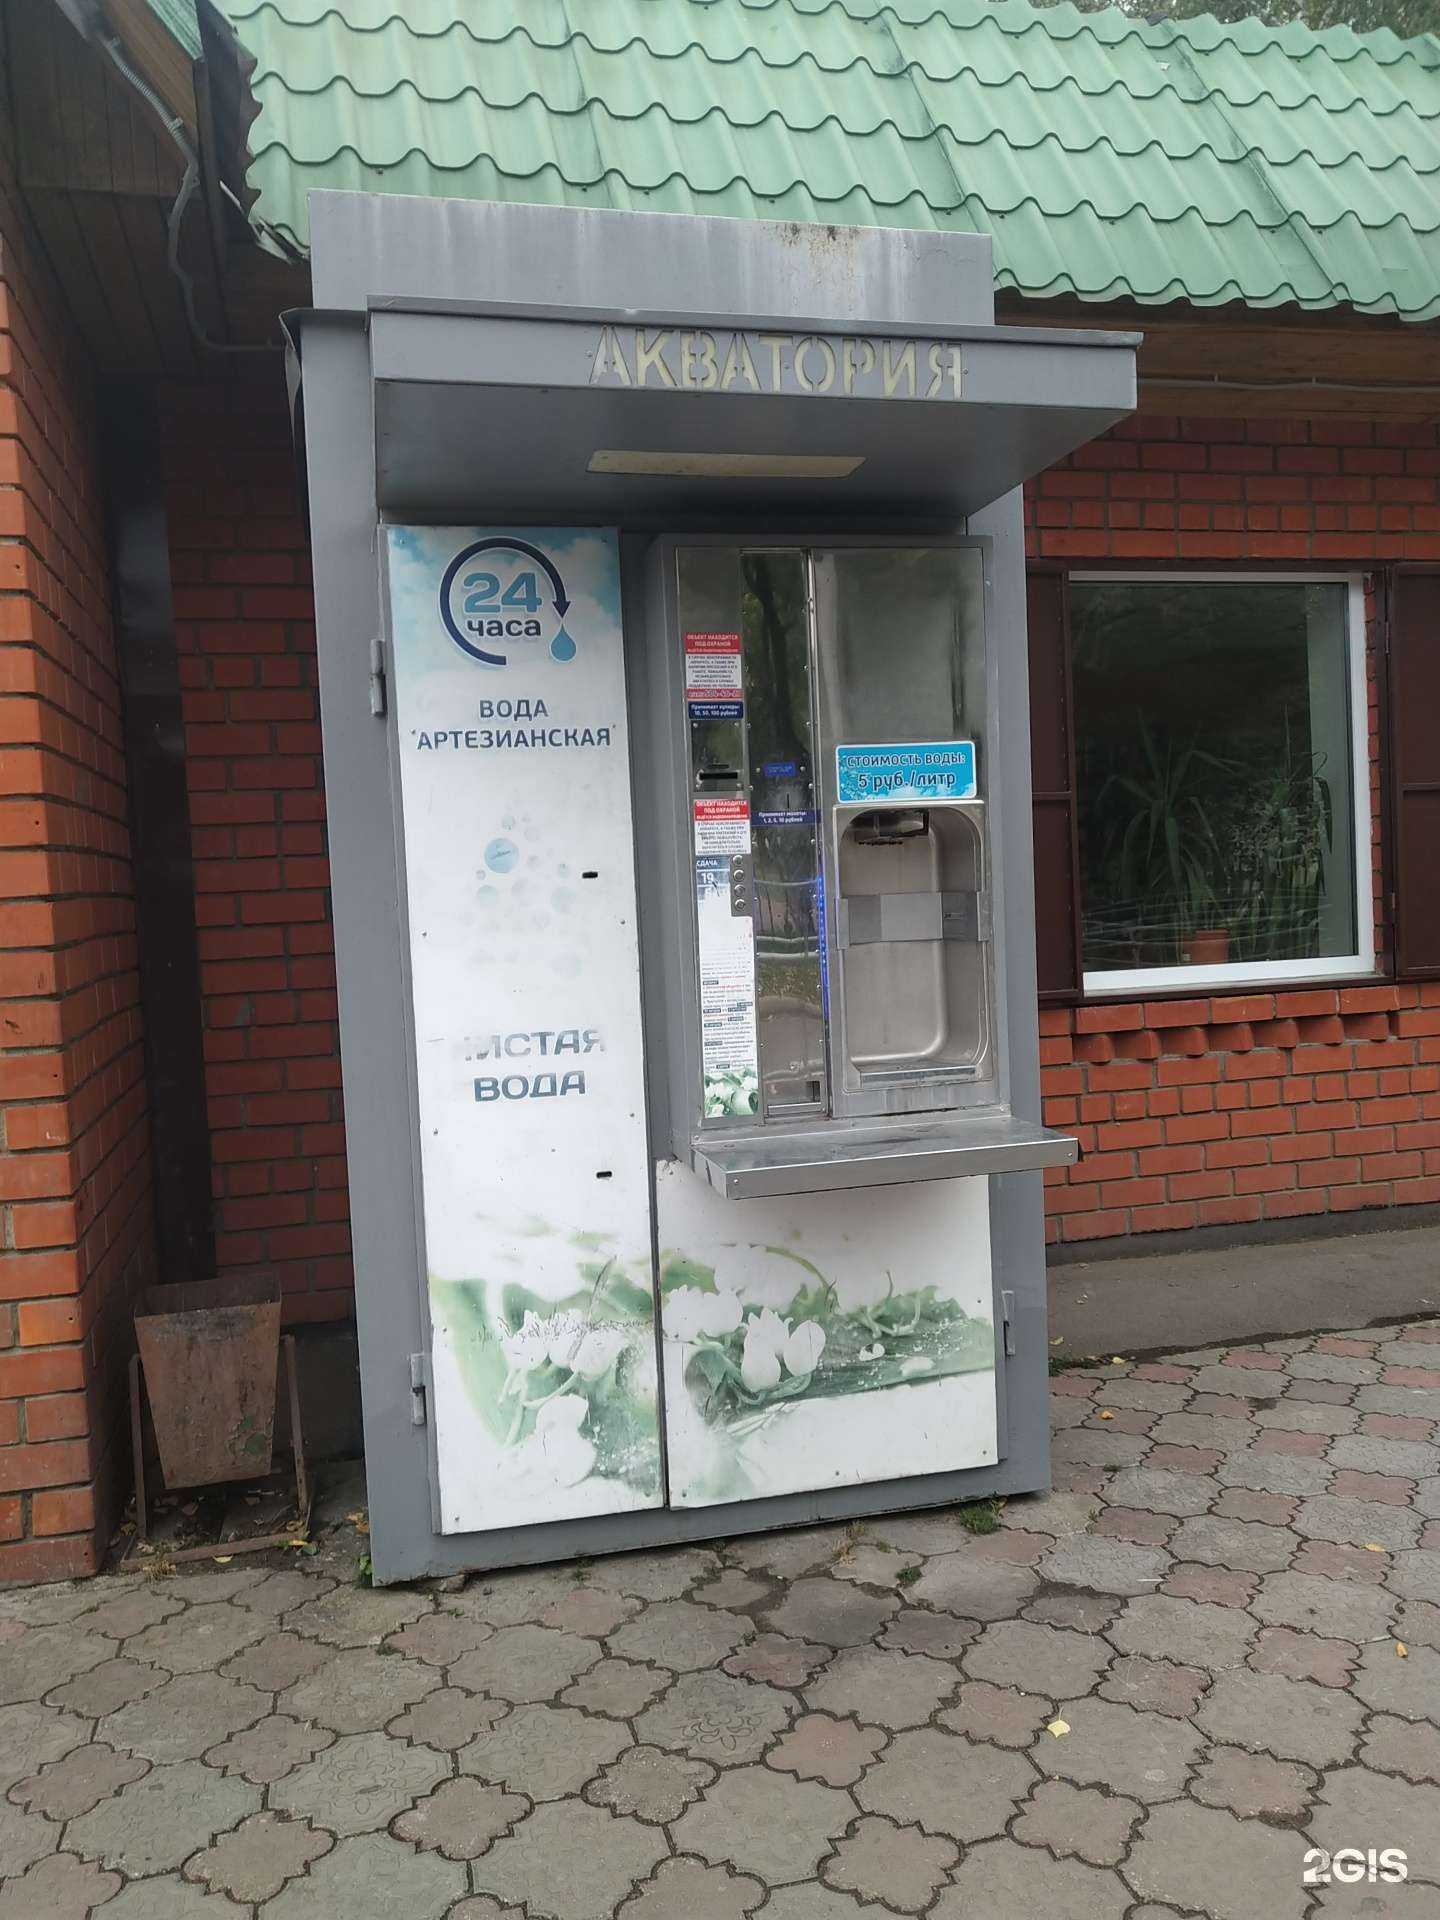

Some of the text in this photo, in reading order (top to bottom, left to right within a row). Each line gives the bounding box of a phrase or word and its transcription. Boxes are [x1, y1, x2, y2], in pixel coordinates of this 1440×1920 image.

[589, 326, 964, 399] АКВАТОРИЯ
[463, 572, 542, 613] 24
[467, 619, 541, 637] часа
[479, 699, 549, 721] ВОДА
[416, 727, 611, 750] АРТЕЗИАНСКАЯ
[858, 771, 956, 791] 5 руб./литр
[463, 1029, 606, 1061] ИСТАЯ
[474, 1070, 586, 1102] ВОДА
